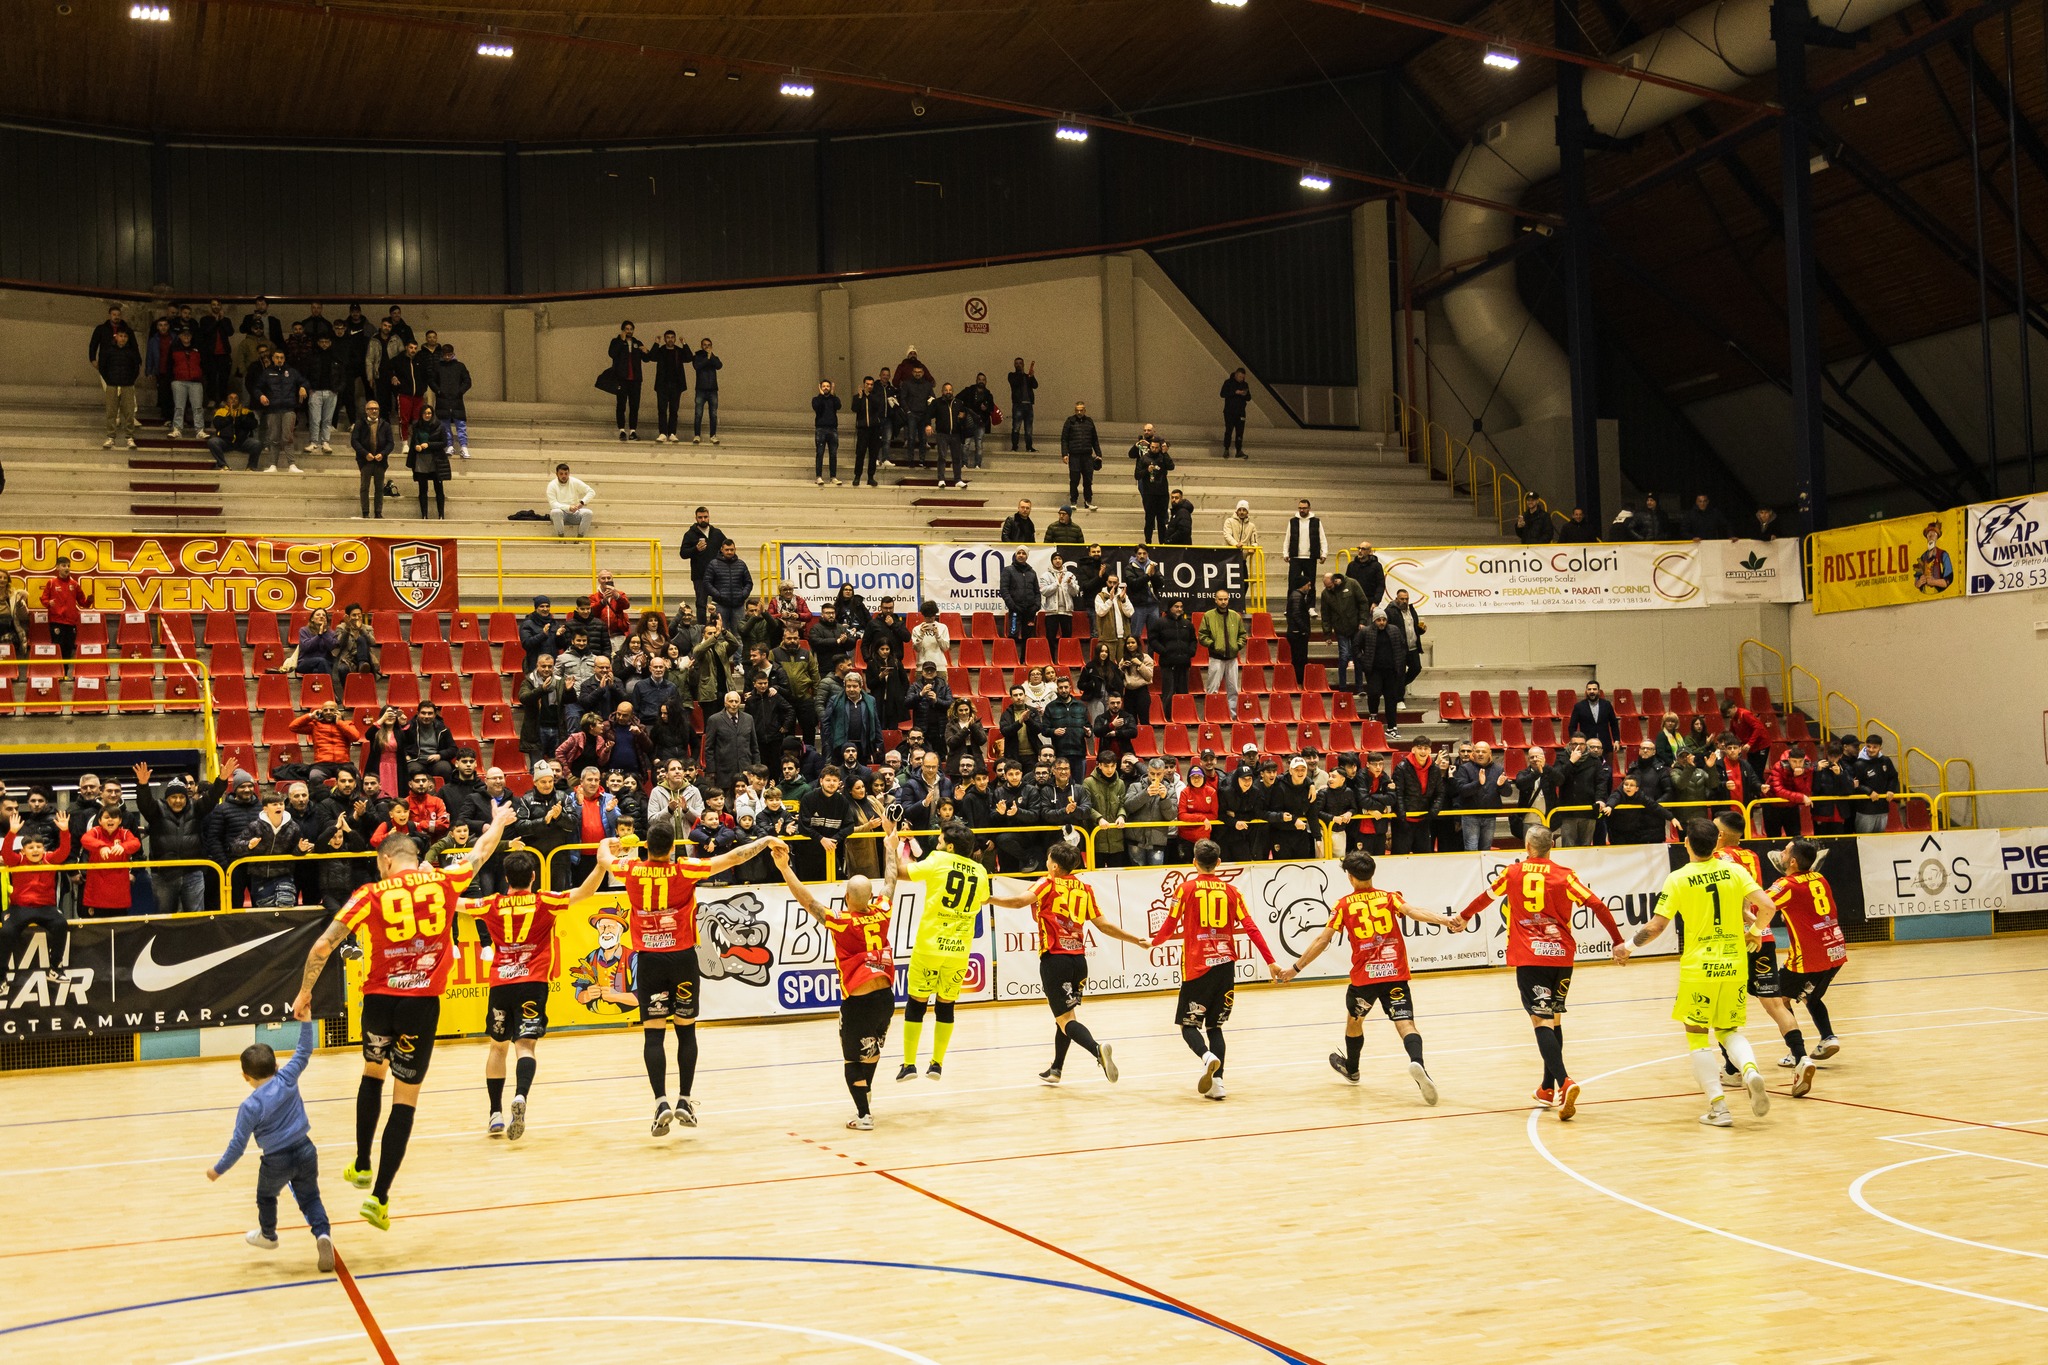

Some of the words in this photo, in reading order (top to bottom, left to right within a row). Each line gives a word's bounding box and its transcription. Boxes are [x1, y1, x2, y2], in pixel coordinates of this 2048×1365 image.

[2010, 521, 2039, 543] AP
[180, 540, 371, 575] CALCIO
[826, 550, 915, 566] Immobiliare
[1465, 552, 1543, 575] Sannio
[1551, 548, 1618, 573] Colori
[1823, 544, 1909, 583] ROSIELLO
[393, 580, 440, 588] BENEVENTO
[827, 567, 914, 590] Duomo
[1509, 575, 1517, 583] di
[1518, 575, 1553, 584] Giuseppe
[1555, 574, 1576, 583] Scalzi
[1726, 568, 1775, 580] zamparelli
[1998, 571, 2024, 589] 328
[2029, 568, 2047, 586] 53
[304, 577, 335, 611] 5
[1433, 588, 1491, 598] TINTOMETRO
[1502, 586, 1561, 596] FERRAMENTA
[1572, 587, 1601, 595] PARATI
[1612, 585, 1650, 594] CORNICI
[938, 602, 961, 611] PRESA
[964, 602, 973, 611] DI
[975, 602, 1002, 611] PULIZIE
[631, 862, 677, 877] BOBADILLA
[953, 861, 976, 875] LEPRE
[1522, 863, 1550, 873] BOTTA
[1688, 869, 1731, 887] MATHEUS
[373, 876, 403, 893] LOLO
[942, 869, 978, 912] 91
[1055, 877, 1085, 889] GUERRA
[1196, 881, 1226, 890] MILUCCI
[1522, 872, 1545, 912] 9
[498, 894, 536, 908] ARVONIO
[639, 877, 668, 911] 11
[1346, 891, 1388, 904] AVVENTURATO
[1705, 883, 1721, 925] 1
[1809, 880, 1831, 916] 8
[381, 882, 446, 943] 93
[1052, 884, 1088, 925] 20
[1195, 890, 1228, 928] 10
[498, 905, 536, 943] 17
[1348, 896, 1393, 939] 35
[1004, 932, 1024, 952] DI
[1457, 951, 1487, 959] BENEVENTO
[445, 987, 479, 999] SAPORE
[1006, 981, 1044, 996] Cors
[1134, 972, 1159, 987] 236
